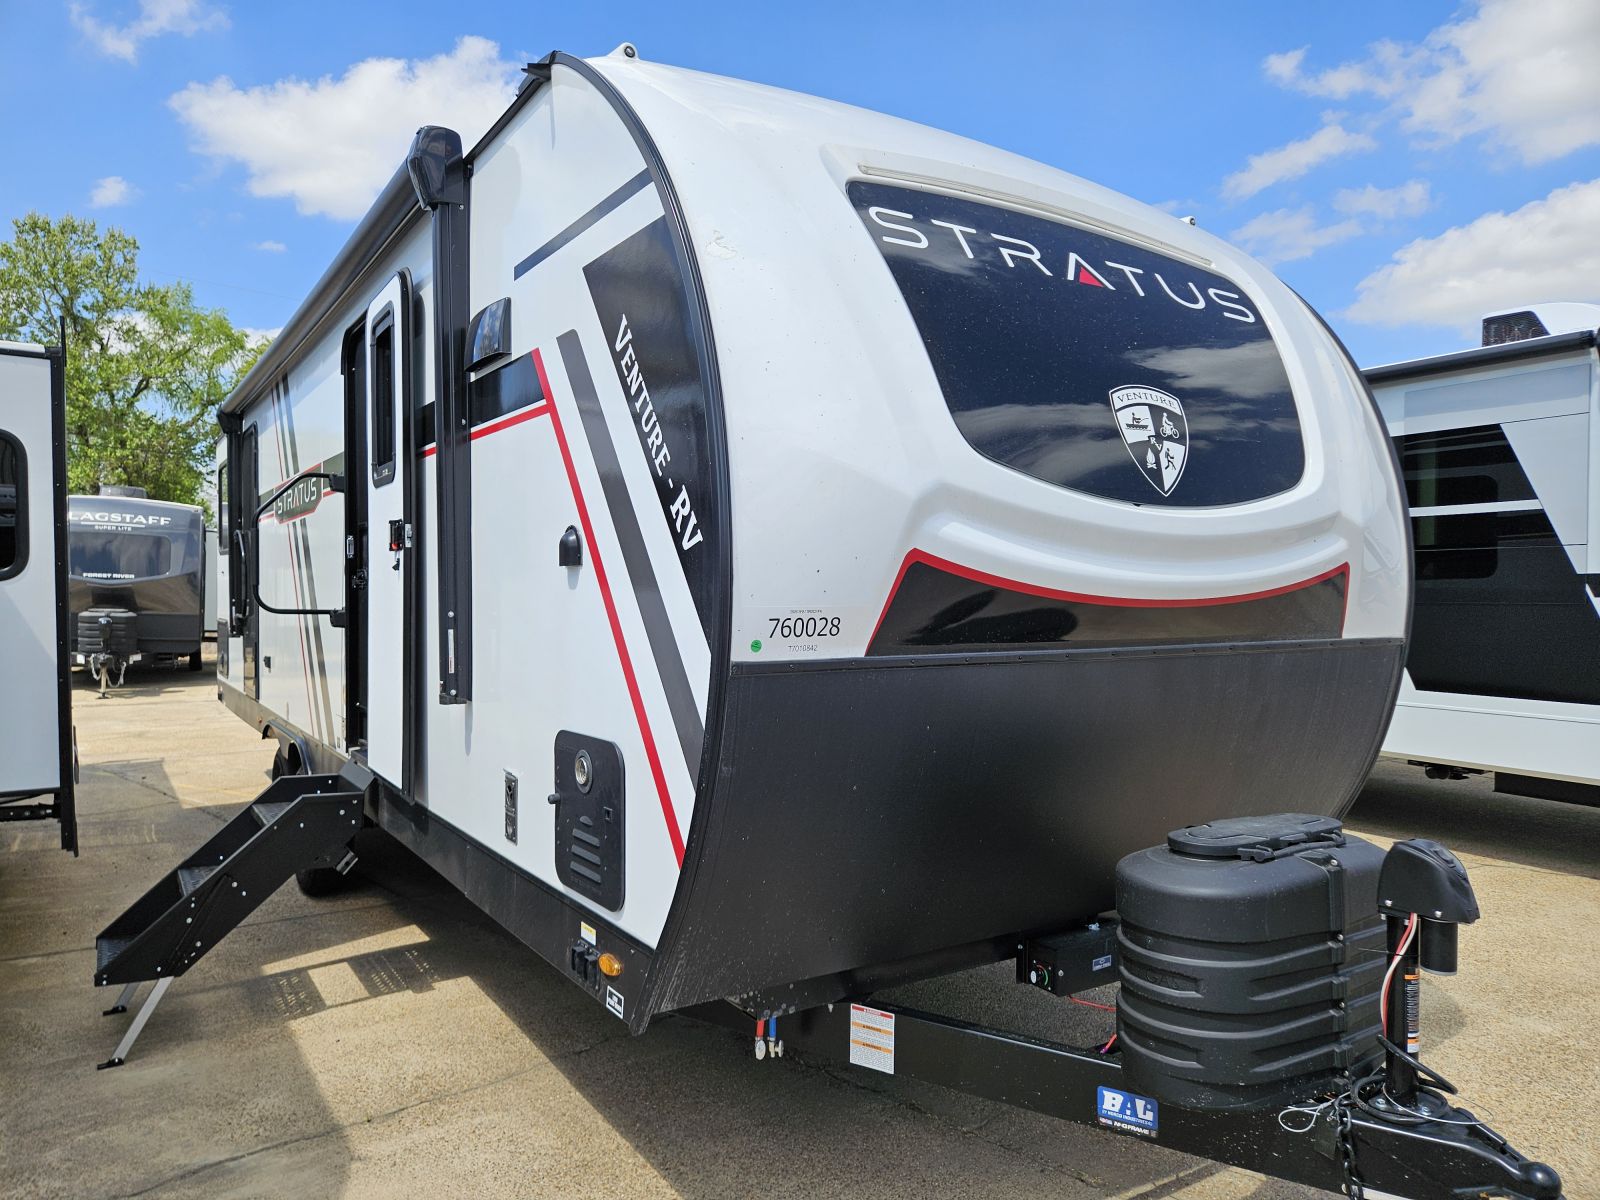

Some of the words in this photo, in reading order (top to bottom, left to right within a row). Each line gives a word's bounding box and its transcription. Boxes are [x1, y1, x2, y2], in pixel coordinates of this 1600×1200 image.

[868, 206, 1256, 324] STRATUS
[1117, 392, 1177, 410] VENTURE
[614, 314, 671, 477] VENTURE
[669, 484, 703, 551] RV
[277, 477, 317, 514] STRATUS
[68, 511, 172, 526] LAGSTAFF
[768, 616, 841, 639] 760028
[1102, 1090, 1154, 1121] BAL
